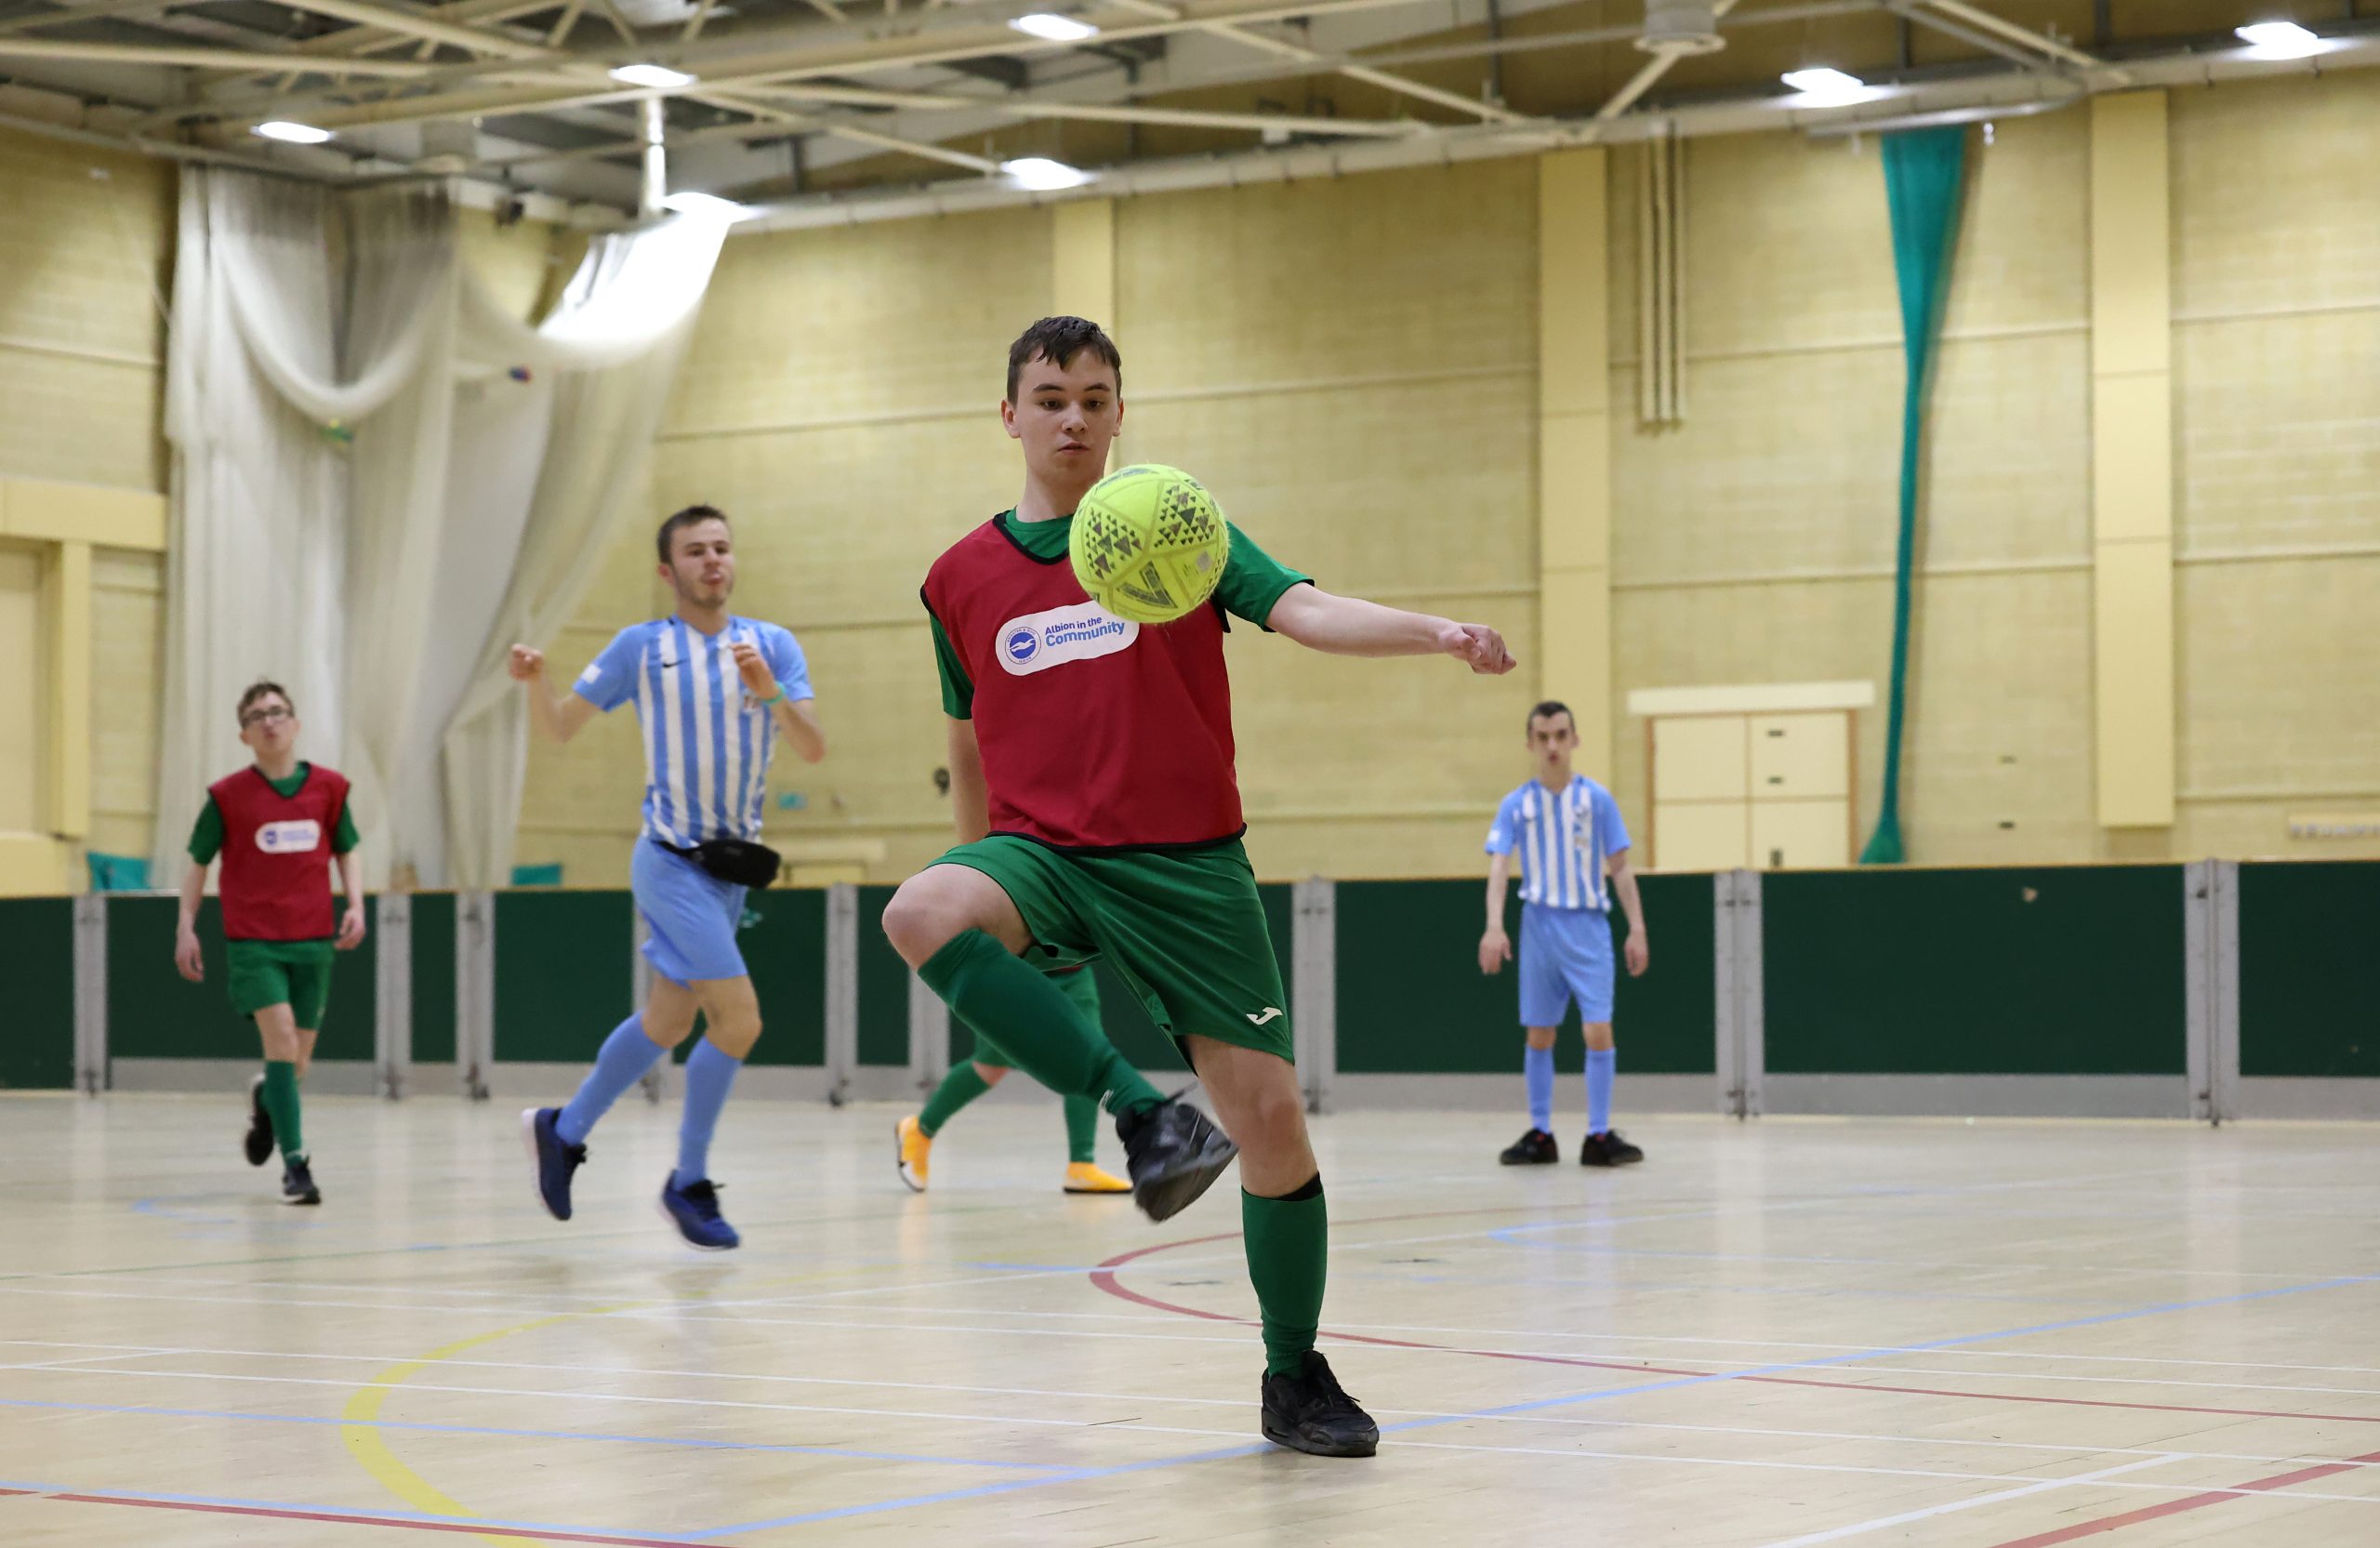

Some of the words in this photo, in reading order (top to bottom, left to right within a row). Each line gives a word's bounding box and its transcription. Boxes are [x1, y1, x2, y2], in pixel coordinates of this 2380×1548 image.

[1045, 622, 1075, 635] Albion
[1088, 616, 1102, 627] the
[1046, 621, 1125, 647] Community
